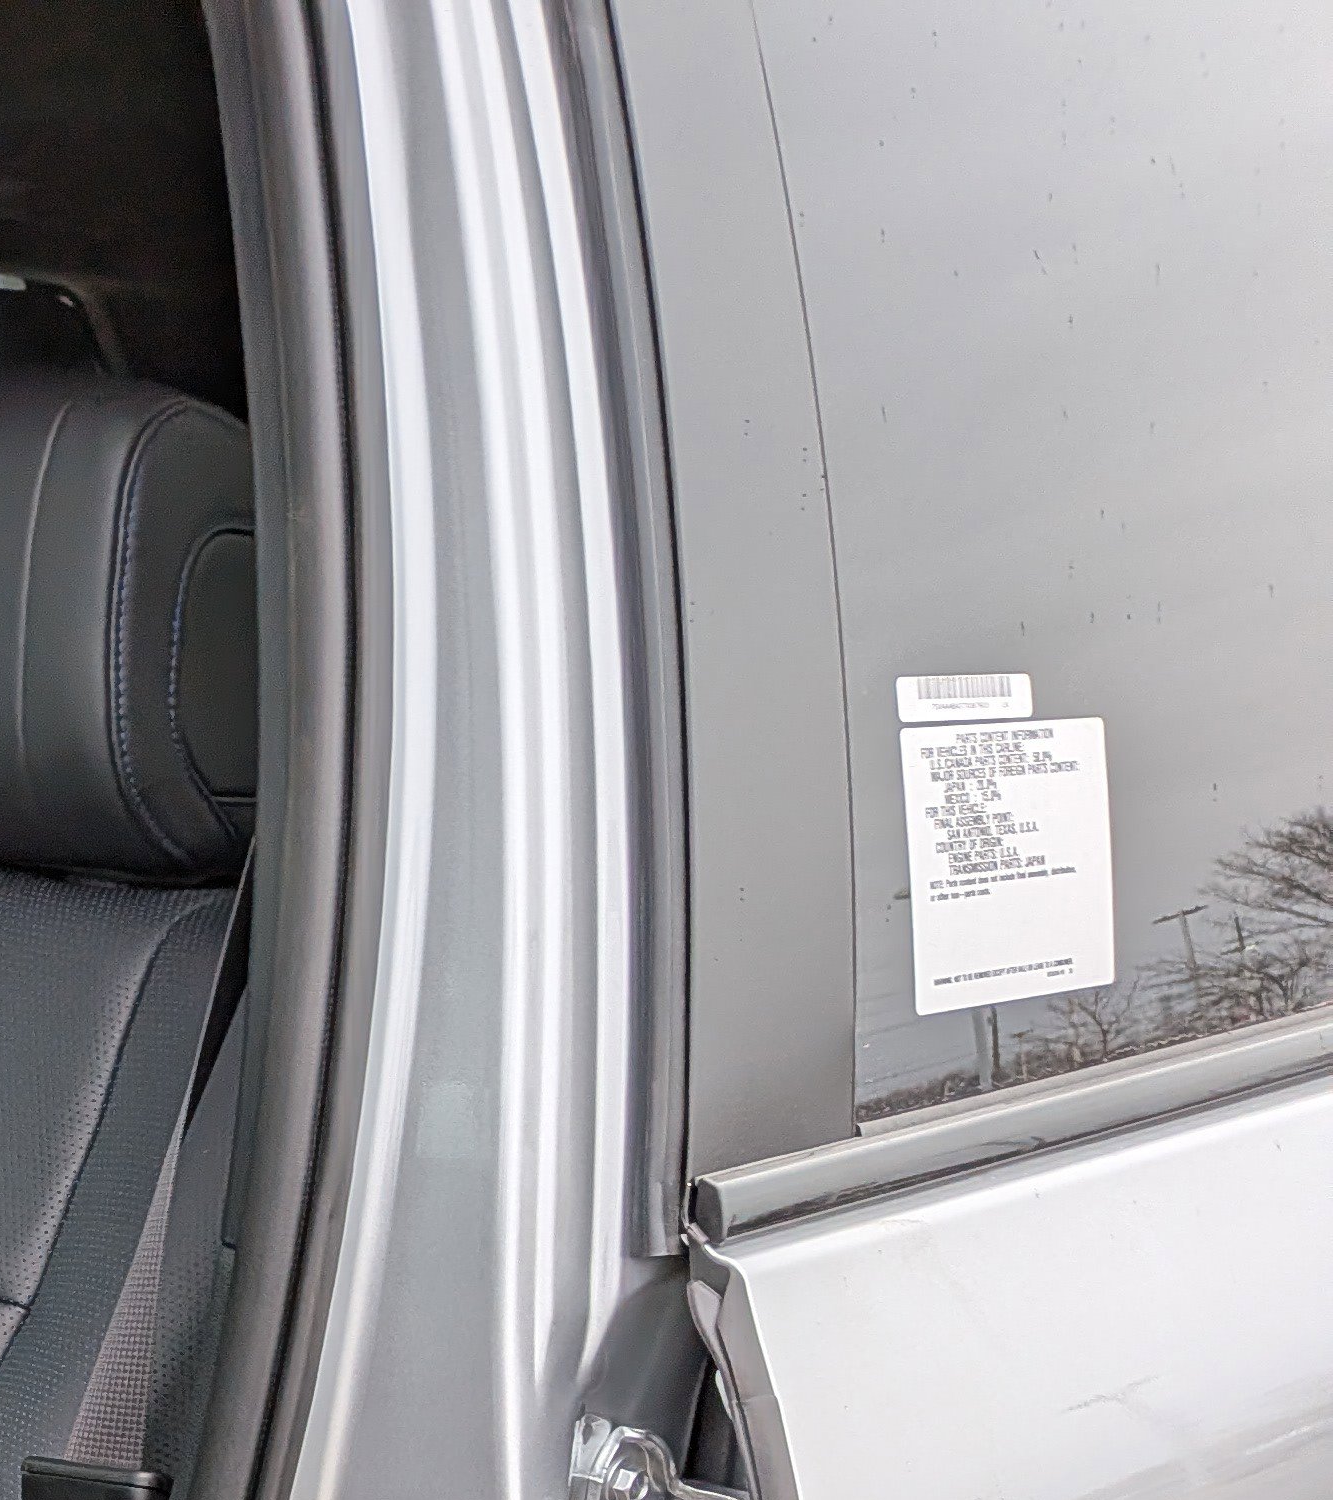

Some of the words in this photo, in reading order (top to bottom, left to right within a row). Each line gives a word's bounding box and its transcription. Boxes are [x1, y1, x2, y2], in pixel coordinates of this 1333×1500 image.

[1011, 728, 1053, 740] INFORMATION
[920, 747, 933, 758] FOR
[956, 768, 985, 780] SOURCES
[956, 814, 989, 827] ASSEMBLY
[946, 828, 960, 840] SAN
[949, 860, 997, 875] TRANSMISSION
